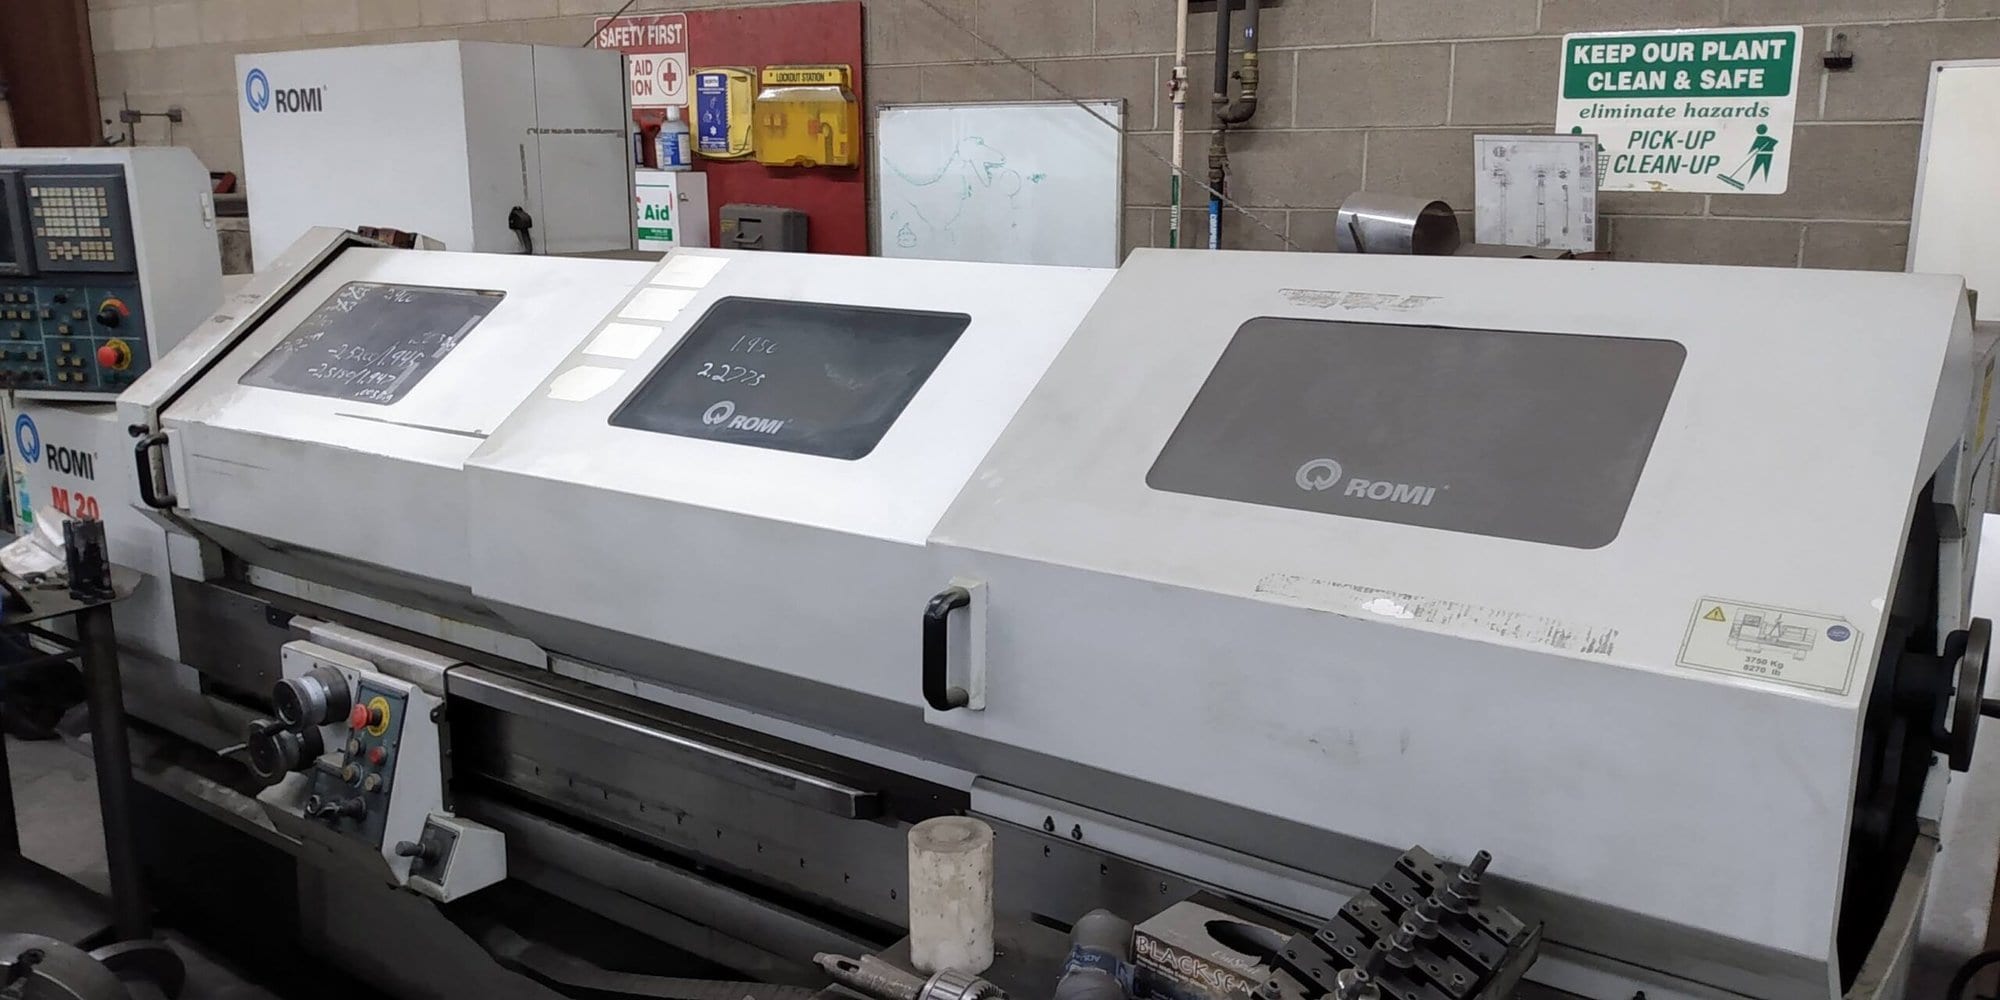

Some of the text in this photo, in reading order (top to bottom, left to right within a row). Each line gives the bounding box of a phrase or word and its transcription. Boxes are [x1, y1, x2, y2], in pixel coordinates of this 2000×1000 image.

[600, 24, 683, 48] SAFETY FIRST
[1574, 39, 1787, 64] KEEP OUR PLANT
[634, 59, 653, 76] AID
[801, 72, 825, 81] STATION
[1587, 69, 1765, 92] CLEAN & SAFE
[275, 87, 322, 113] ROMI
[1579, 102, 1770, 119] eliminate hazards
[1627, 130, 1716, 150] PICK-UP
[1613, 155, 1720, 174] CLEAN-UP
[645, 204, 669, 221] Aid
[727, 415, 784, 434] ROMI
[46, 444, 95, 480] ROMI
[51, 486, 100, 520] M 20
[1344, 478, 1436, 506] ROMI
[1136, 935, 1213, 984] BLACK
